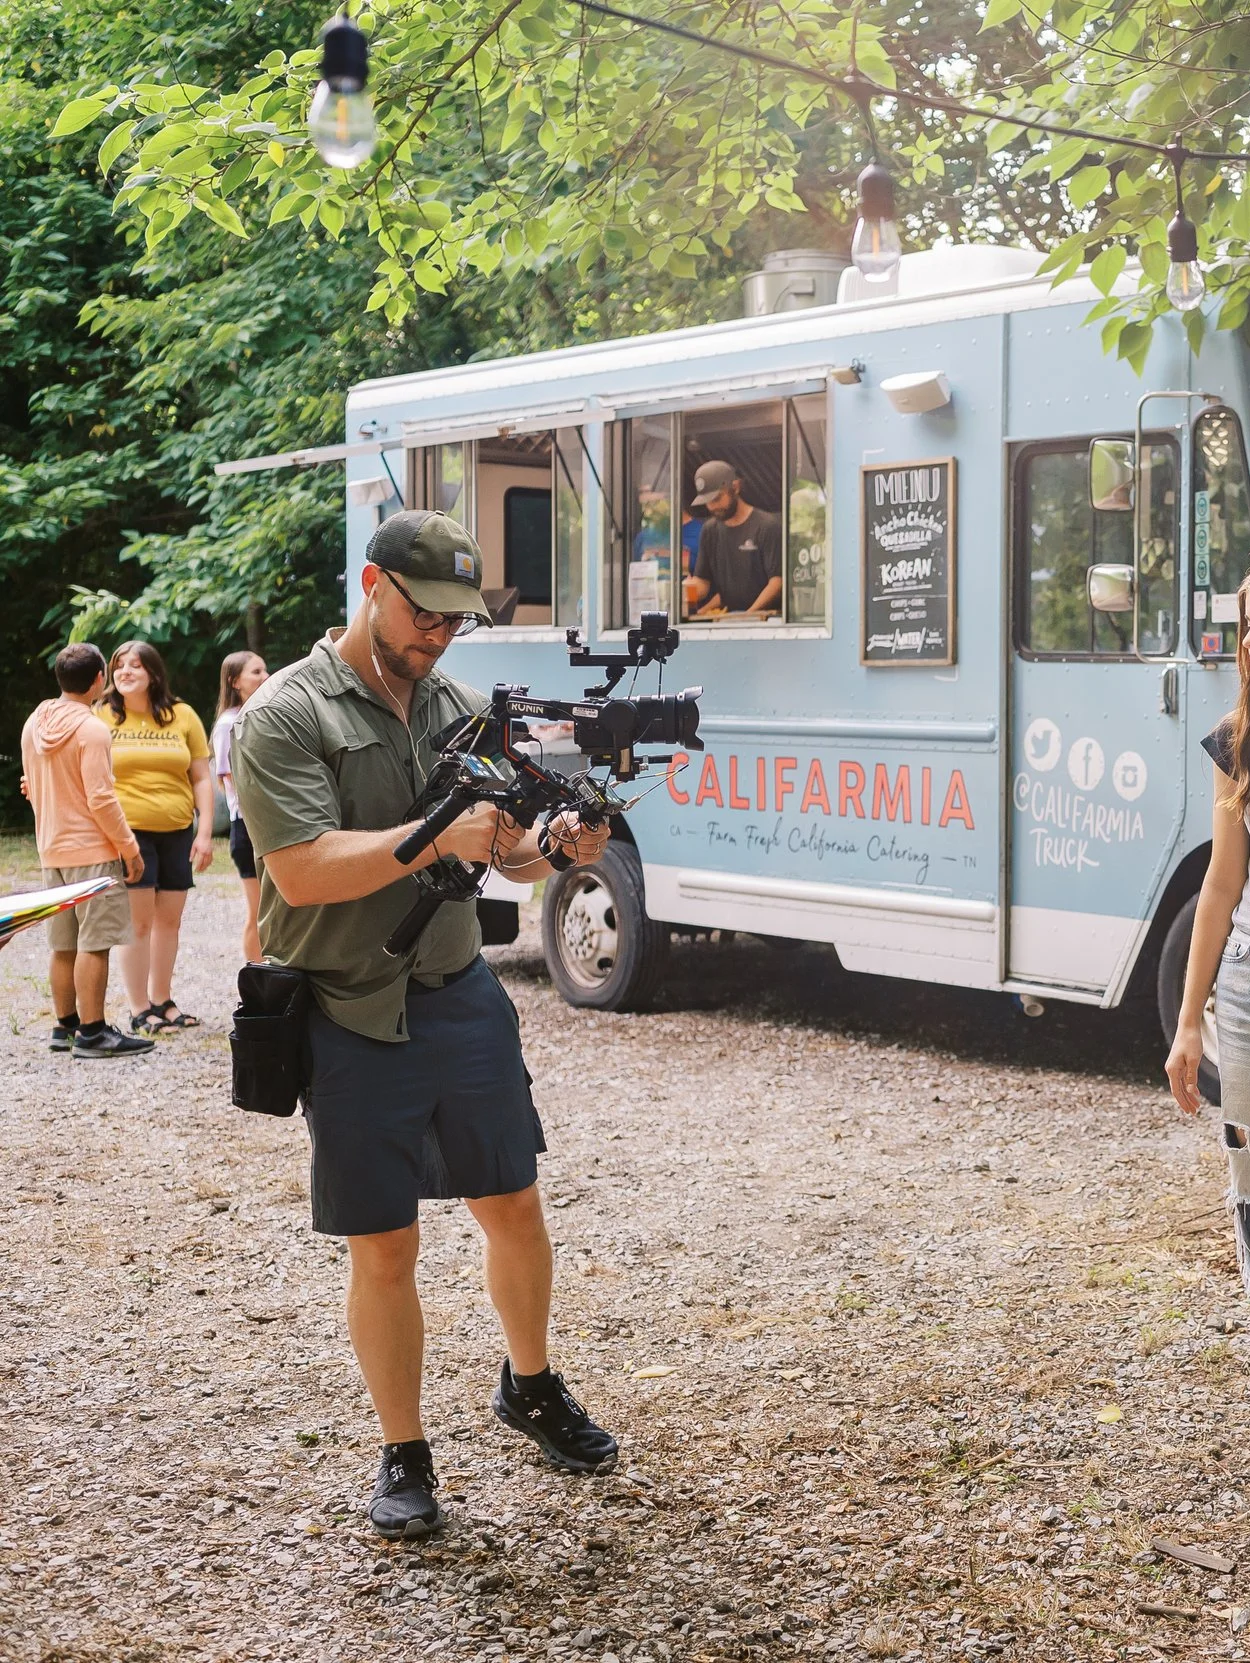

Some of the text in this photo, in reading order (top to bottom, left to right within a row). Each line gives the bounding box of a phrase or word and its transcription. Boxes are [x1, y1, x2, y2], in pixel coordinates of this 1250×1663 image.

[873, 467, 941, 506] MENU
[881, 557, 932, 586] KOREAN
[511, 702, 545, 714] RONIN
[111, 728, 179, 741] Institute
[666, 751, 976, 831] CALIFARMIA
[1013, 772, 1145, 843] @CALIFARMIA
[669, 815, 977, 885] CA Farm Fresh California Catering TN
[1028, 827, 1100, 873] TRUCK
